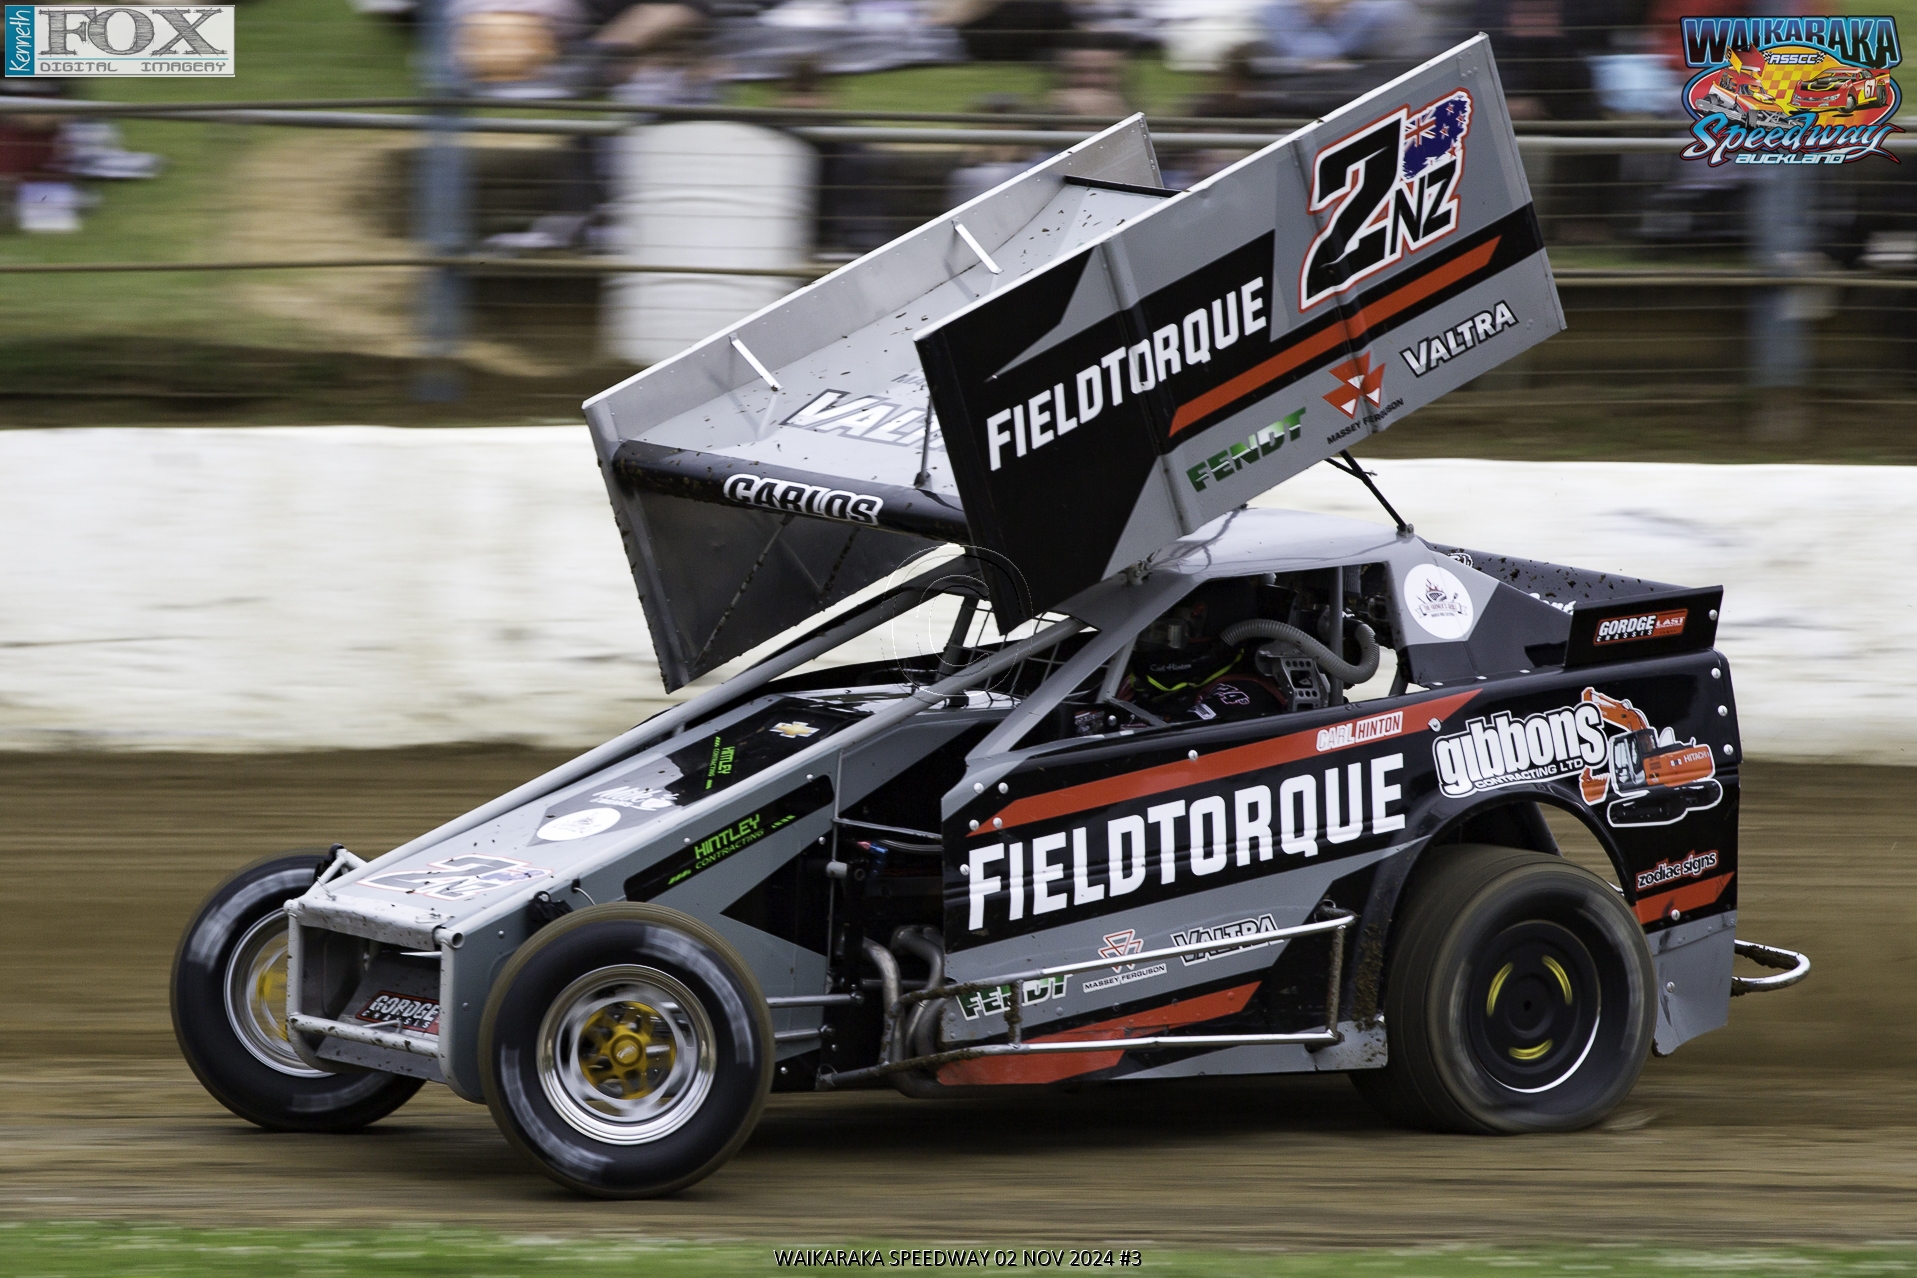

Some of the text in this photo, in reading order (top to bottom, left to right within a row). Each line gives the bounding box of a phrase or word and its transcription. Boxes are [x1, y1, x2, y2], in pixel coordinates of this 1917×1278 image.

[1400, 300, 1520, 378] VALTRA
[986, 276, 1267, 472] FIELDTORQUE
[1186, 407, 1307, 493] FENDT
[1326, 420, 1361, 445] MASSEY
[723, 473, 884, 525] CARLOS
[1596, 629, 1653, 643] CHASSIS
[1598, 614, 1657, 636] GORDGE
[1317, 713, 1402, 752] CARL HINTON
[1434, 702, 1609, 796] gibbons
[1474, 758, 1585, 789] CONTRACTING LTD
[694, 813, 761, 860] HINTLEY
[695, 828, 765, 869] CONTRACTING
[968, 752, 1406, 931] FIELDTORQUE
[1637, 853, 1717, 888] zodiac signs
[1084, 965, 1166, 990] MASSEY FERGUSON
[368, 994, 441, 1022] GORDGE
